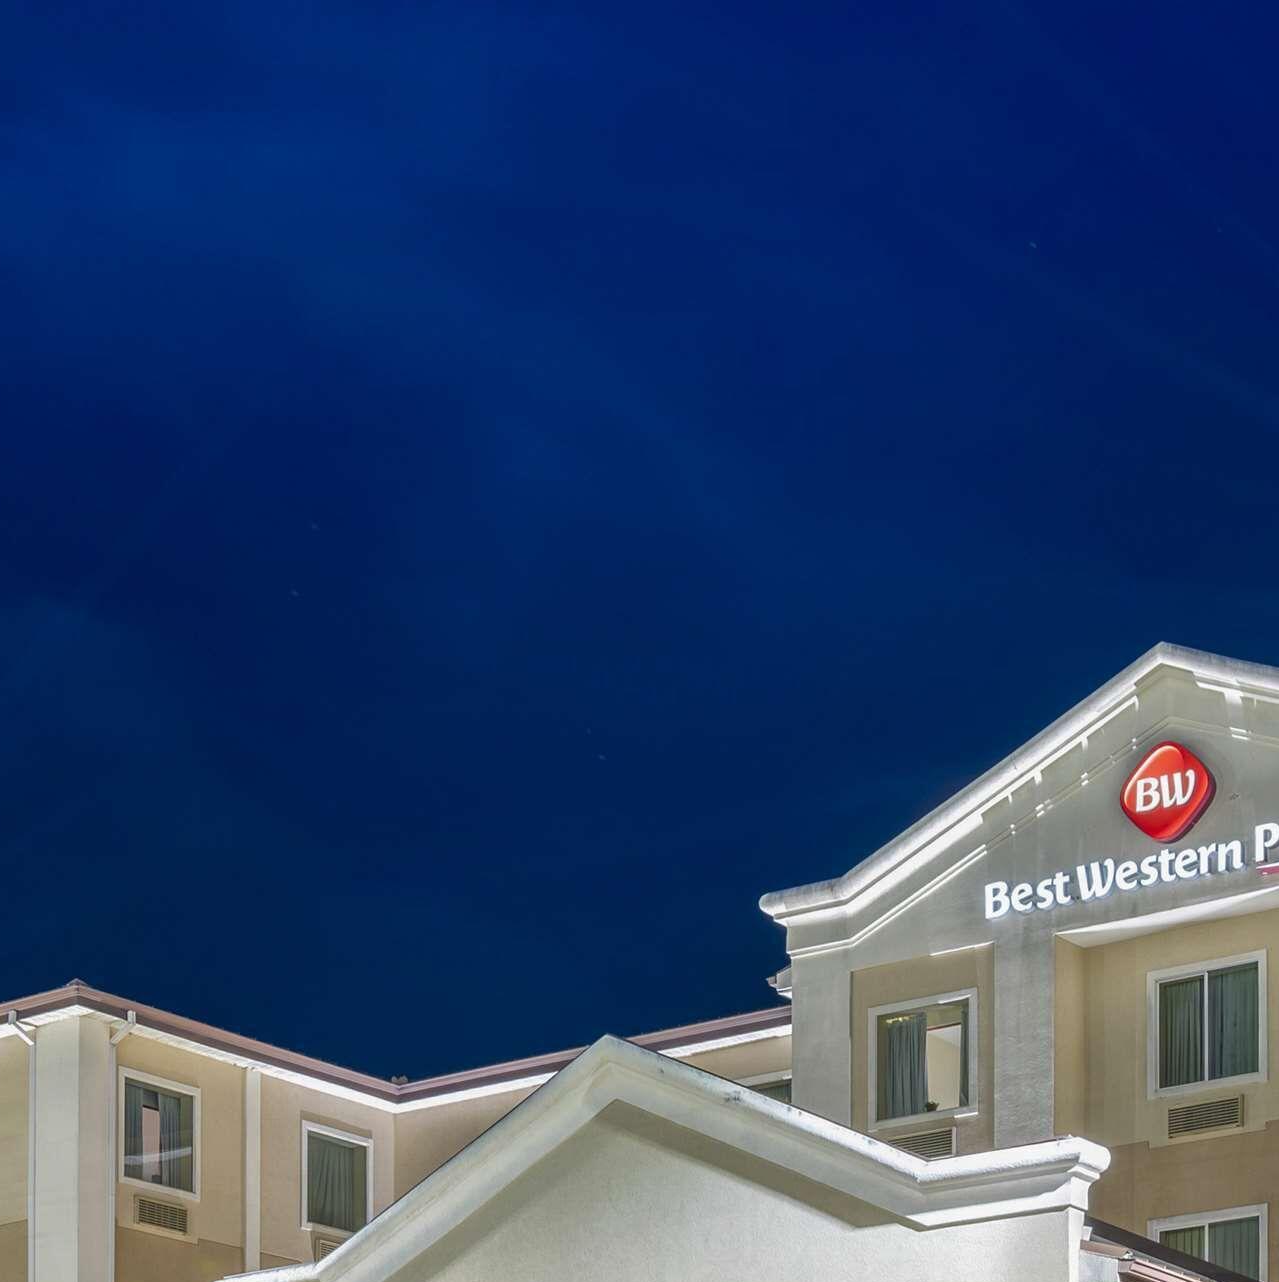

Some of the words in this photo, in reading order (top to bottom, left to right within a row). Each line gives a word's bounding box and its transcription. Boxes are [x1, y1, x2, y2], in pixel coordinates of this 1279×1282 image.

[1135, 769, 1195, 813] BW
[985, 872, 1072, 919] Best
[1076, 839, 1243, 901] Western
